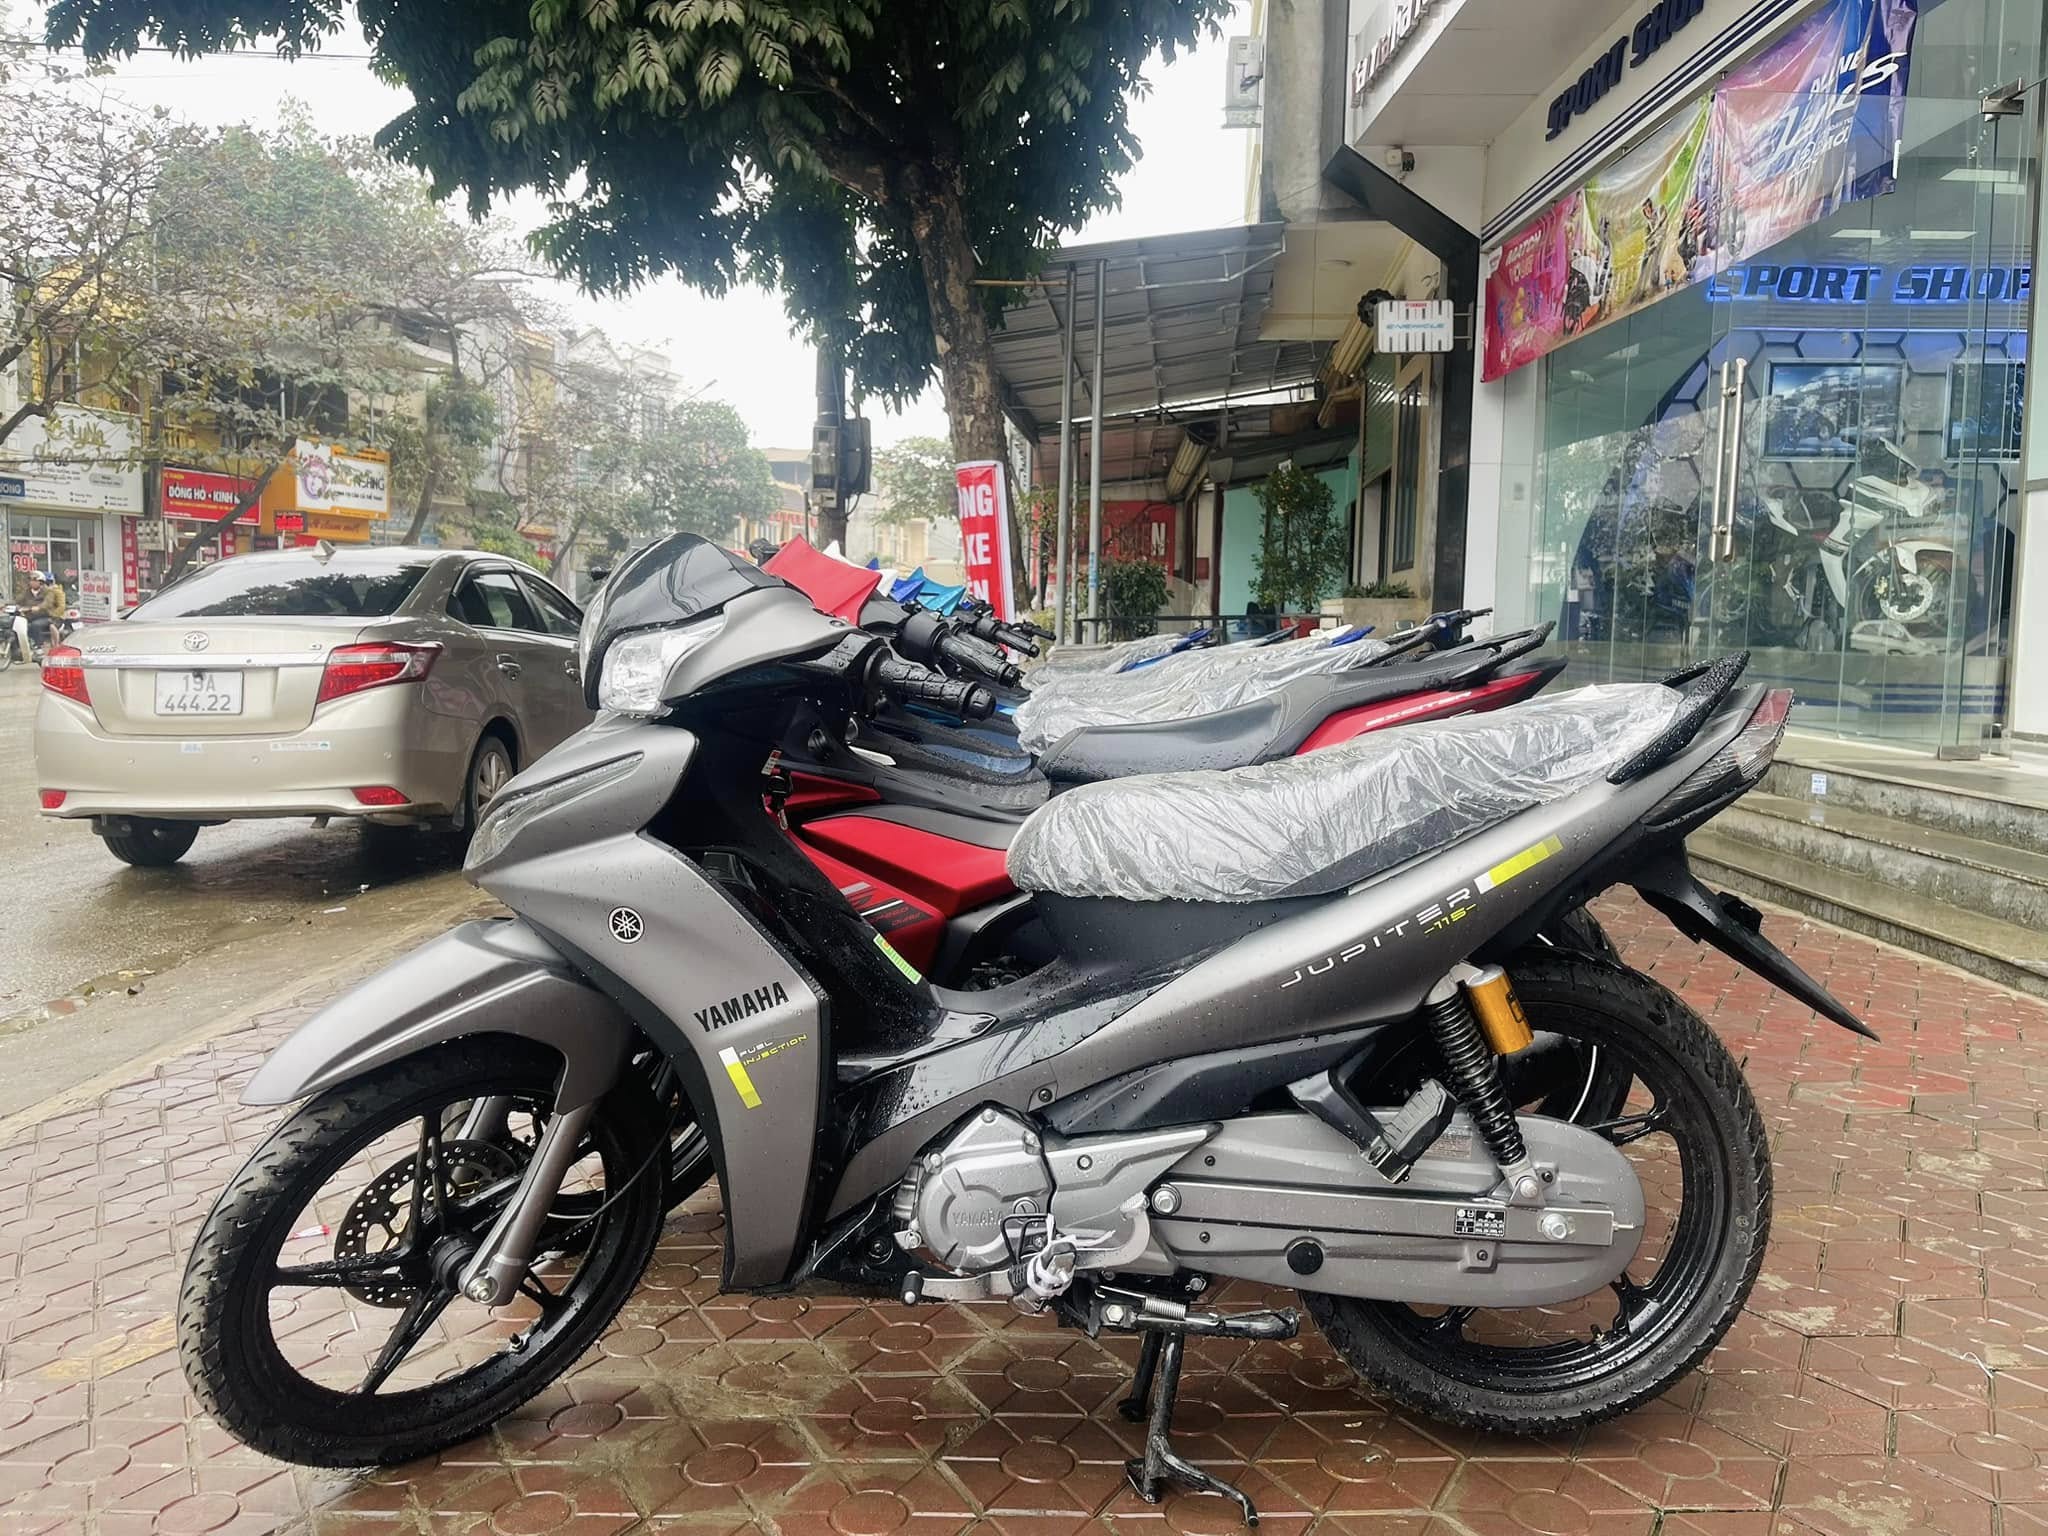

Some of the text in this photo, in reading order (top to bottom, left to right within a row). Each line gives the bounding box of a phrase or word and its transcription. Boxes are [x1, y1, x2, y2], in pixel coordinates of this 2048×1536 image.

[1545, 0, 1704, 142] SPORT SHO
[1707, 264, 1881, 303] SPORT
[212, 490, 233, 505] KINH
[182, 675, 216, 692] 19A
[165, 695, 231, 712] 444.22
[1280, 887, 1471, 989] JUPITER
[693, 981, 790, 1033] YAMAHA
[739, 1041, 774, 1058] FUEL
[743, 1033, 808, 1066] INJECTION
